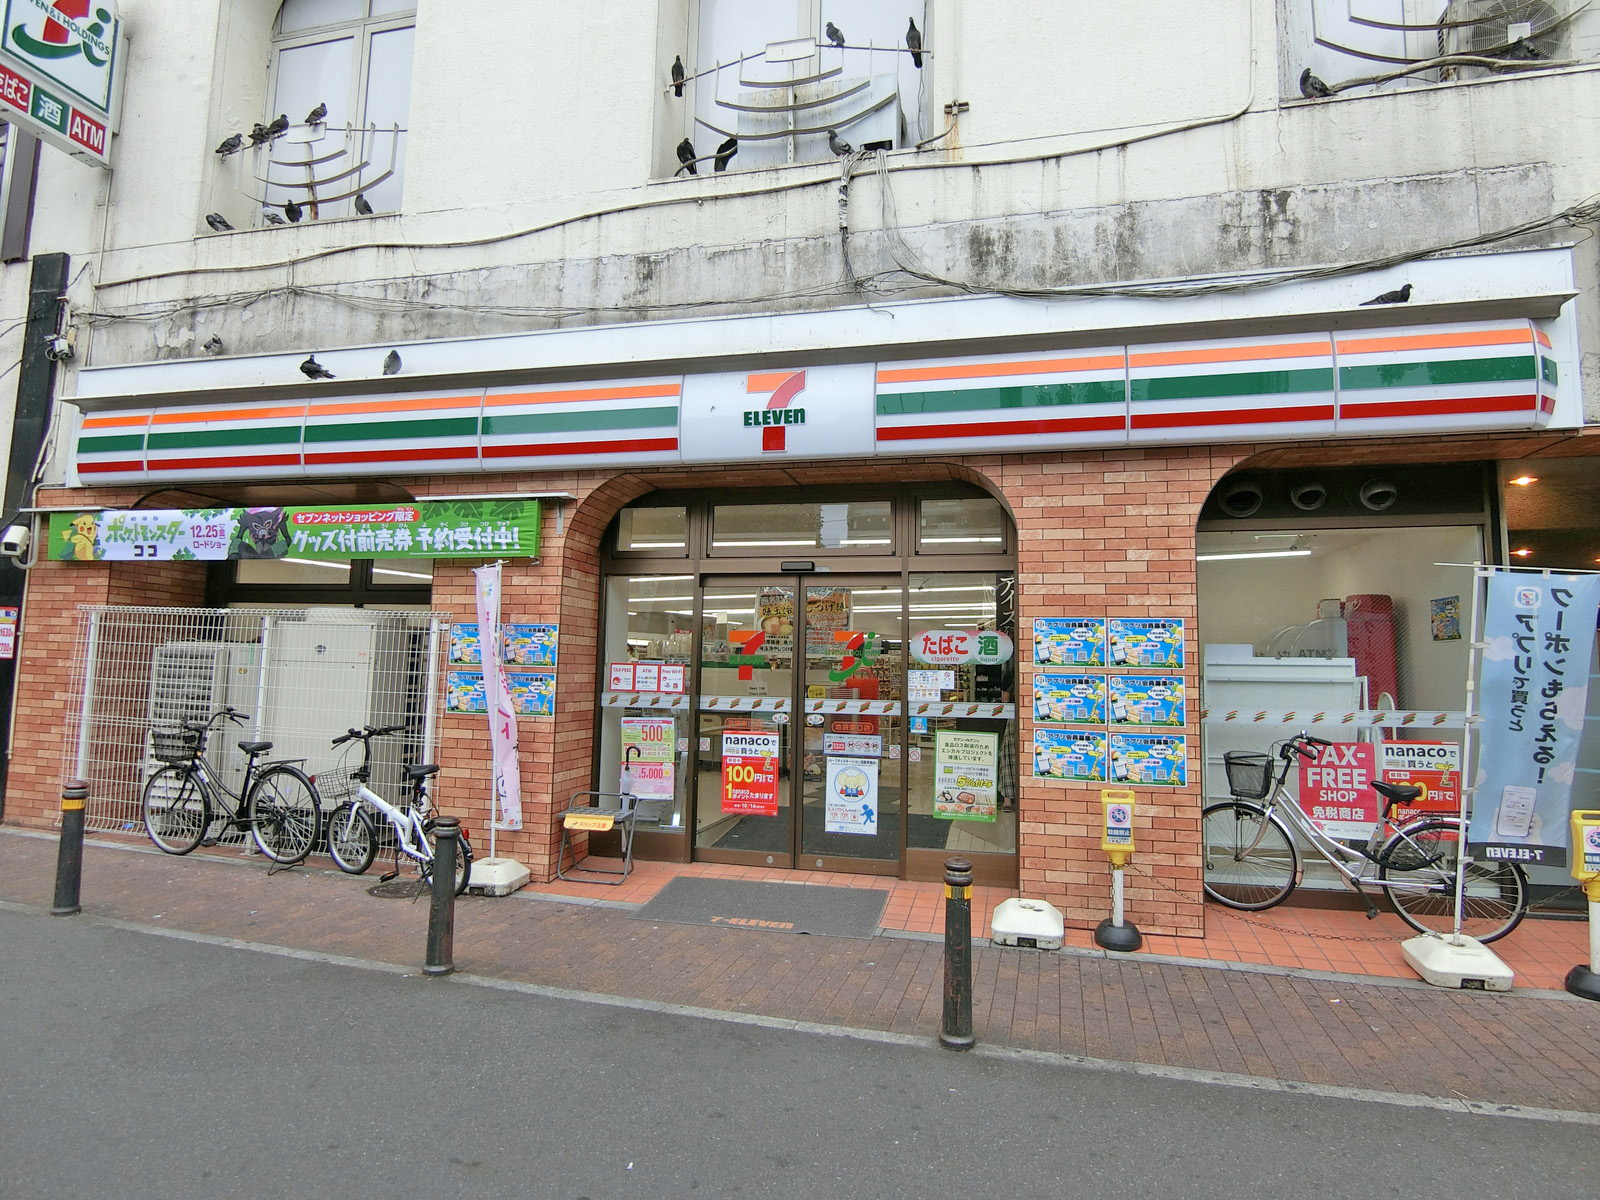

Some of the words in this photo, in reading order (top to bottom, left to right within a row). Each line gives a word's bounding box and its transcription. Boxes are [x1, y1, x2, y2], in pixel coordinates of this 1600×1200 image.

[62, 18, 110, 56] HOLDINGS
[38, 93, 63, 127] 酒
[71, 115, 104, 151] ATM
[105, 514, 186, 545] ポケットモンスター
[192, 541, 227, 549] ロードショー
[292, 527, 414, 553] グッズ付前売券
[133, 544, 158, 557] ココ
[922, 635, 969, 655] たばこ
[977, 635, 999, 656] 酒
[641, 724, 663, 742] 500
[1306, 745, 1366, 766] TAX-
[1407, 760, 1433, 769] 買うと
[640, 767, 663, 779] 5,000
[1307, 767, 1368, 790] FREE
[1319, 790, 1358, 802] SHOP
[1312, 806, 1365, 820] 免税商店
